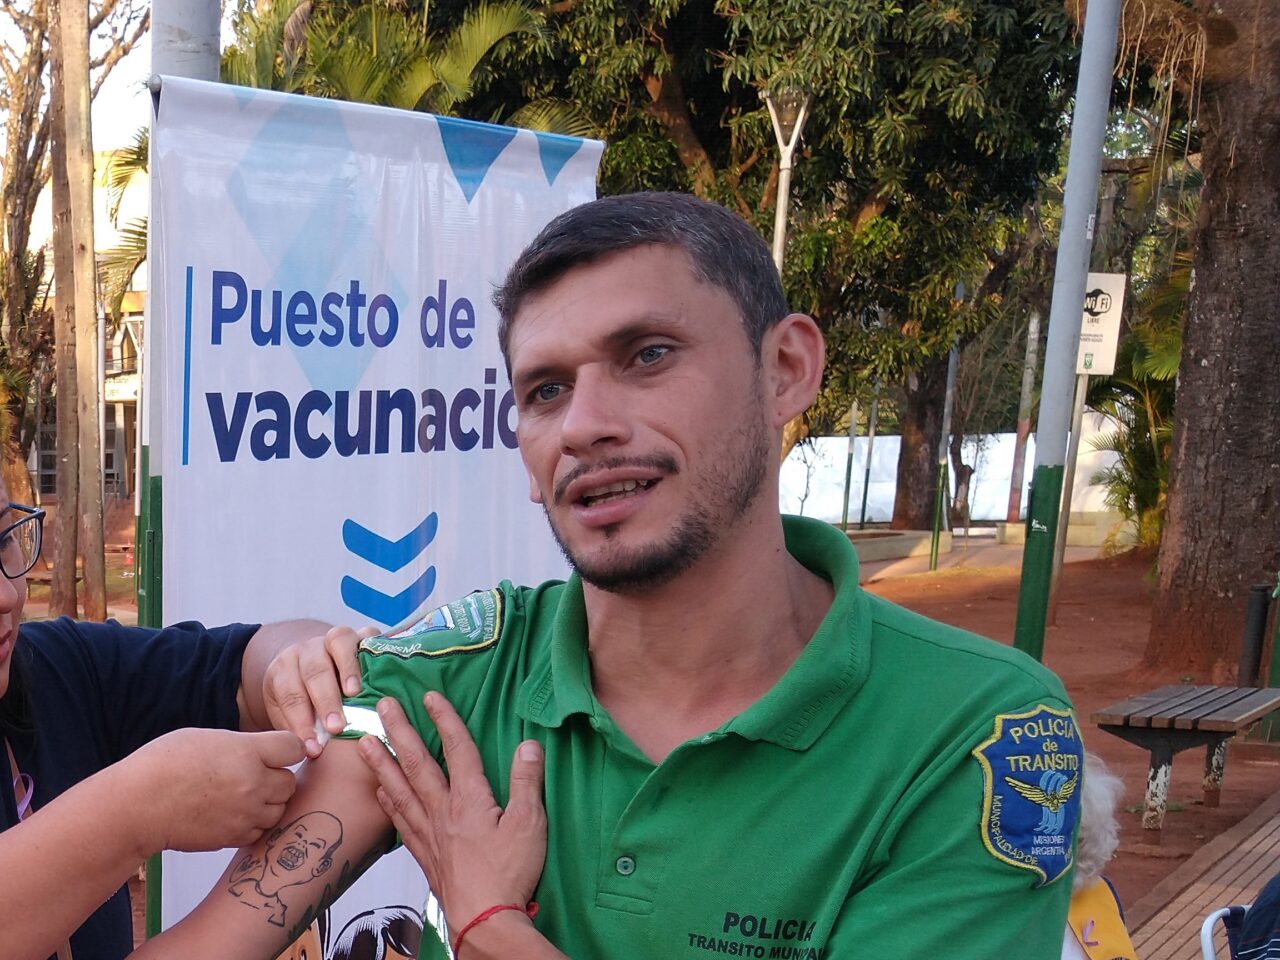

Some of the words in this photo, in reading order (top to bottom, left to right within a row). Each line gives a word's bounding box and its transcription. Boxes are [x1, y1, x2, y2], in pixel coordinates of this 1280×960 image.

[209, 270, 399, 349] Puesto
[420, 279, 476, 349] de
[1009, 718, 1075, 744] POLICIA
[1042, 738, 1058, 752] de
[1005, 752, 1079, 772] TRANSITO
[723, 911, 816, 942] POLICIA
[688, 932, 765, 959] TRANSITO
